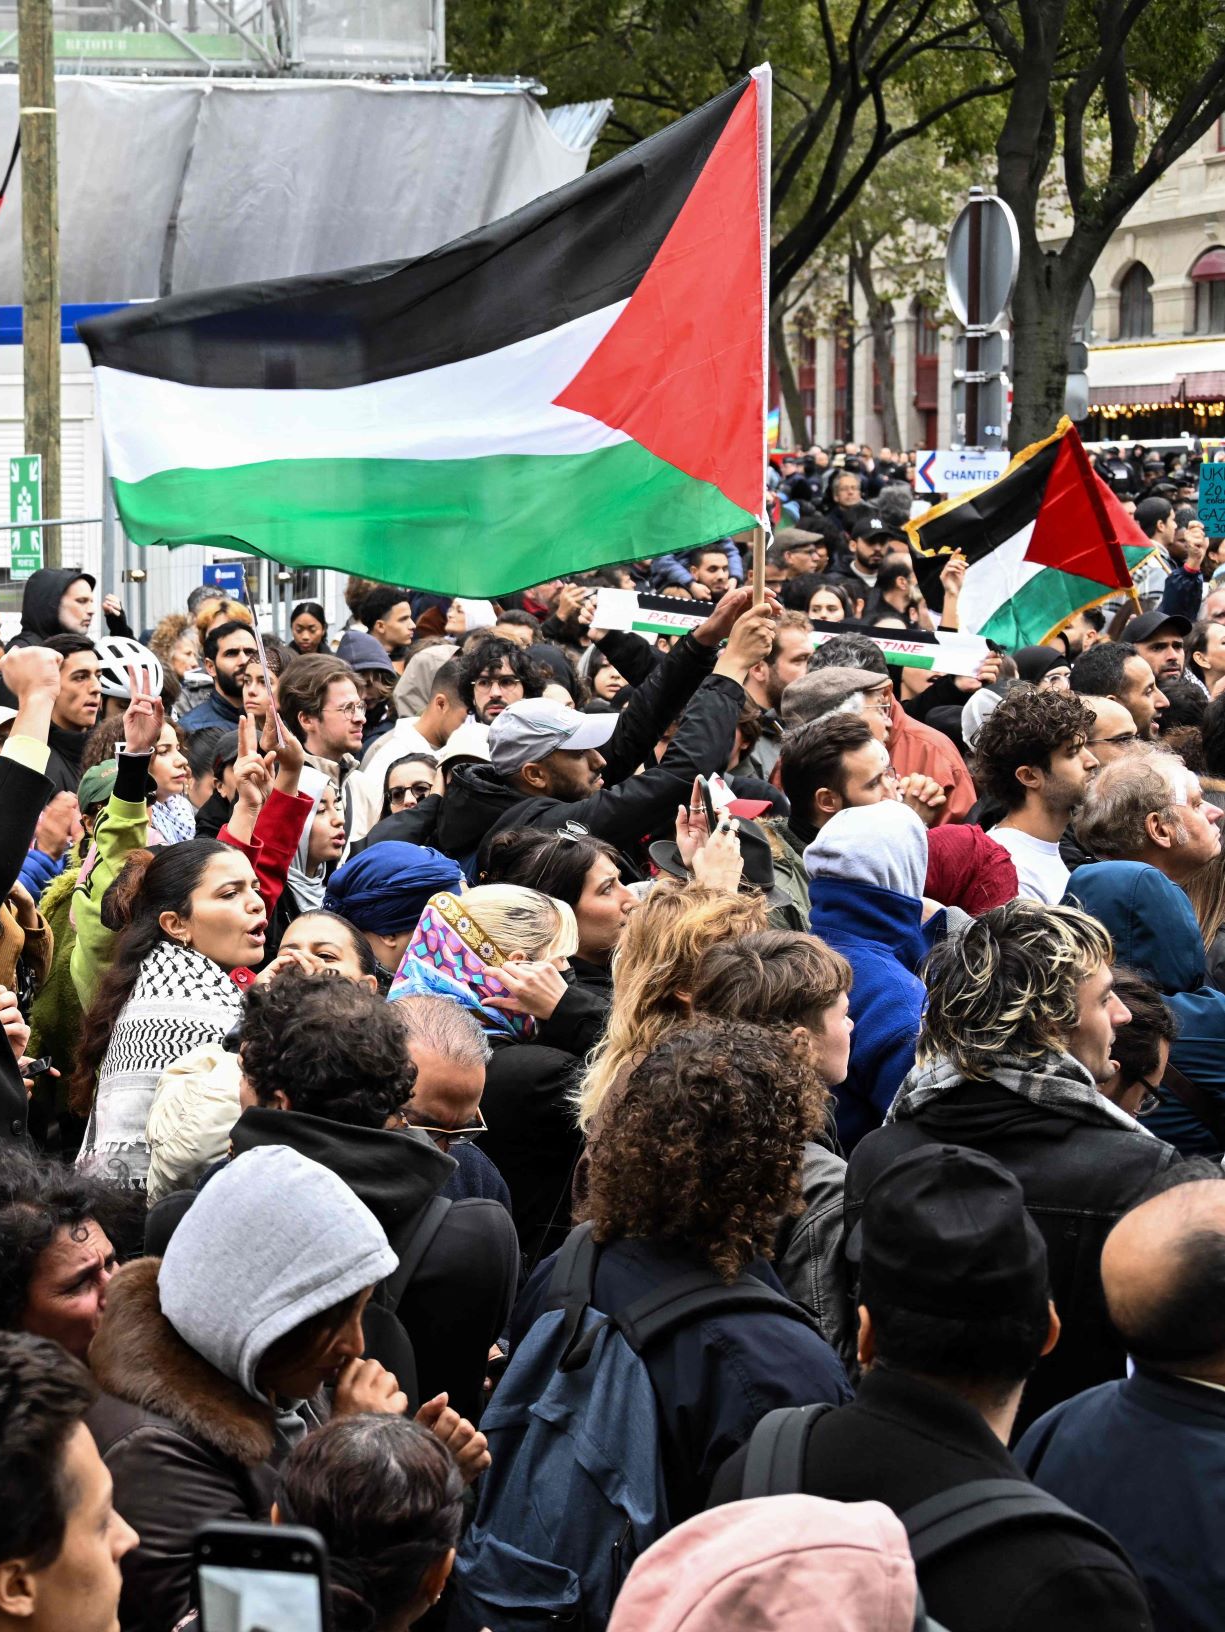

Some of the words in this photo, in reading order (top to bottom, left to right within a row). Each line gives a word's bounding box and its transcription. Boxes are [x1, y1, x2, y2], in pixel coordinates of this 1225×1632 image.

[944, 470, 1000, 480] CHANTIER
[1202, 466, 1225, 481] UK
[647, 612, 702, 627] PALES
